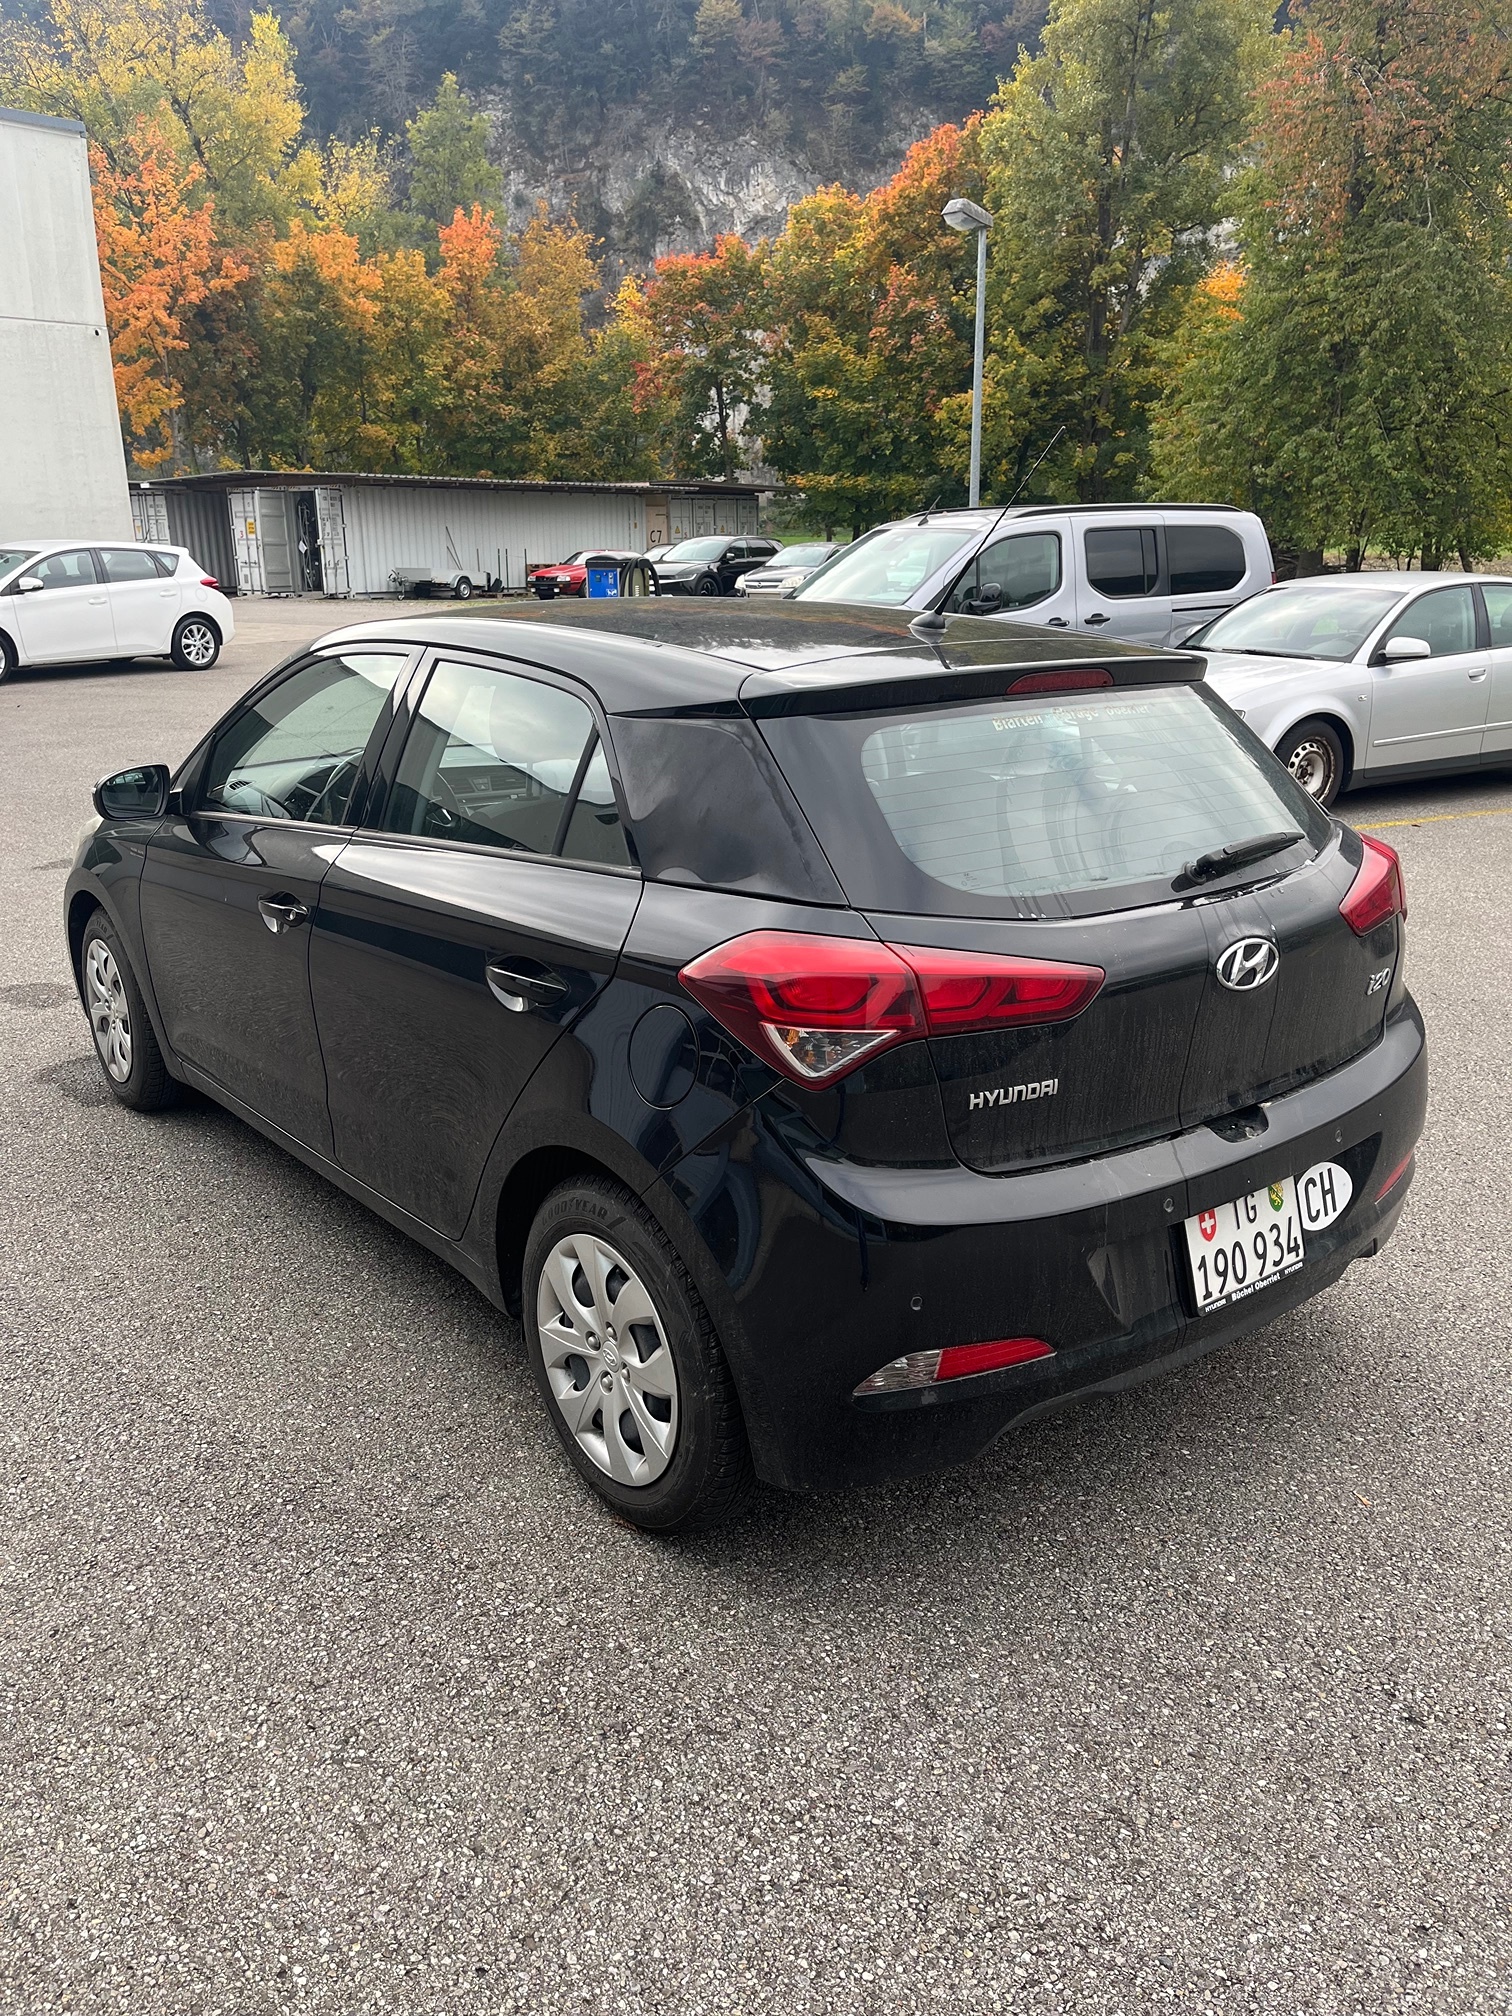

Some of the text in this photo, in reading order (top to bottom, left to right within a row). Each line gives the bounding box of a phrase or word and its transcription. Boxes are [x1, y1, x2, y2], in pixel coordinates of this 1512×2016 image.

[649, 530, 663, 544] C7
[1366, 967, 1391, 996] i20
[969, 1078, 1059, 1110] HYUNDAI
[1304, 1167, 1338, 1223] CH
[1230, 1193, 1258, 1230] TG
[1197, 1215, 1301, 1301] 190 934
[1231, 1285, 1254, 1302] Büchel
[1254, 1272, 1281, 1290] Oberriet
